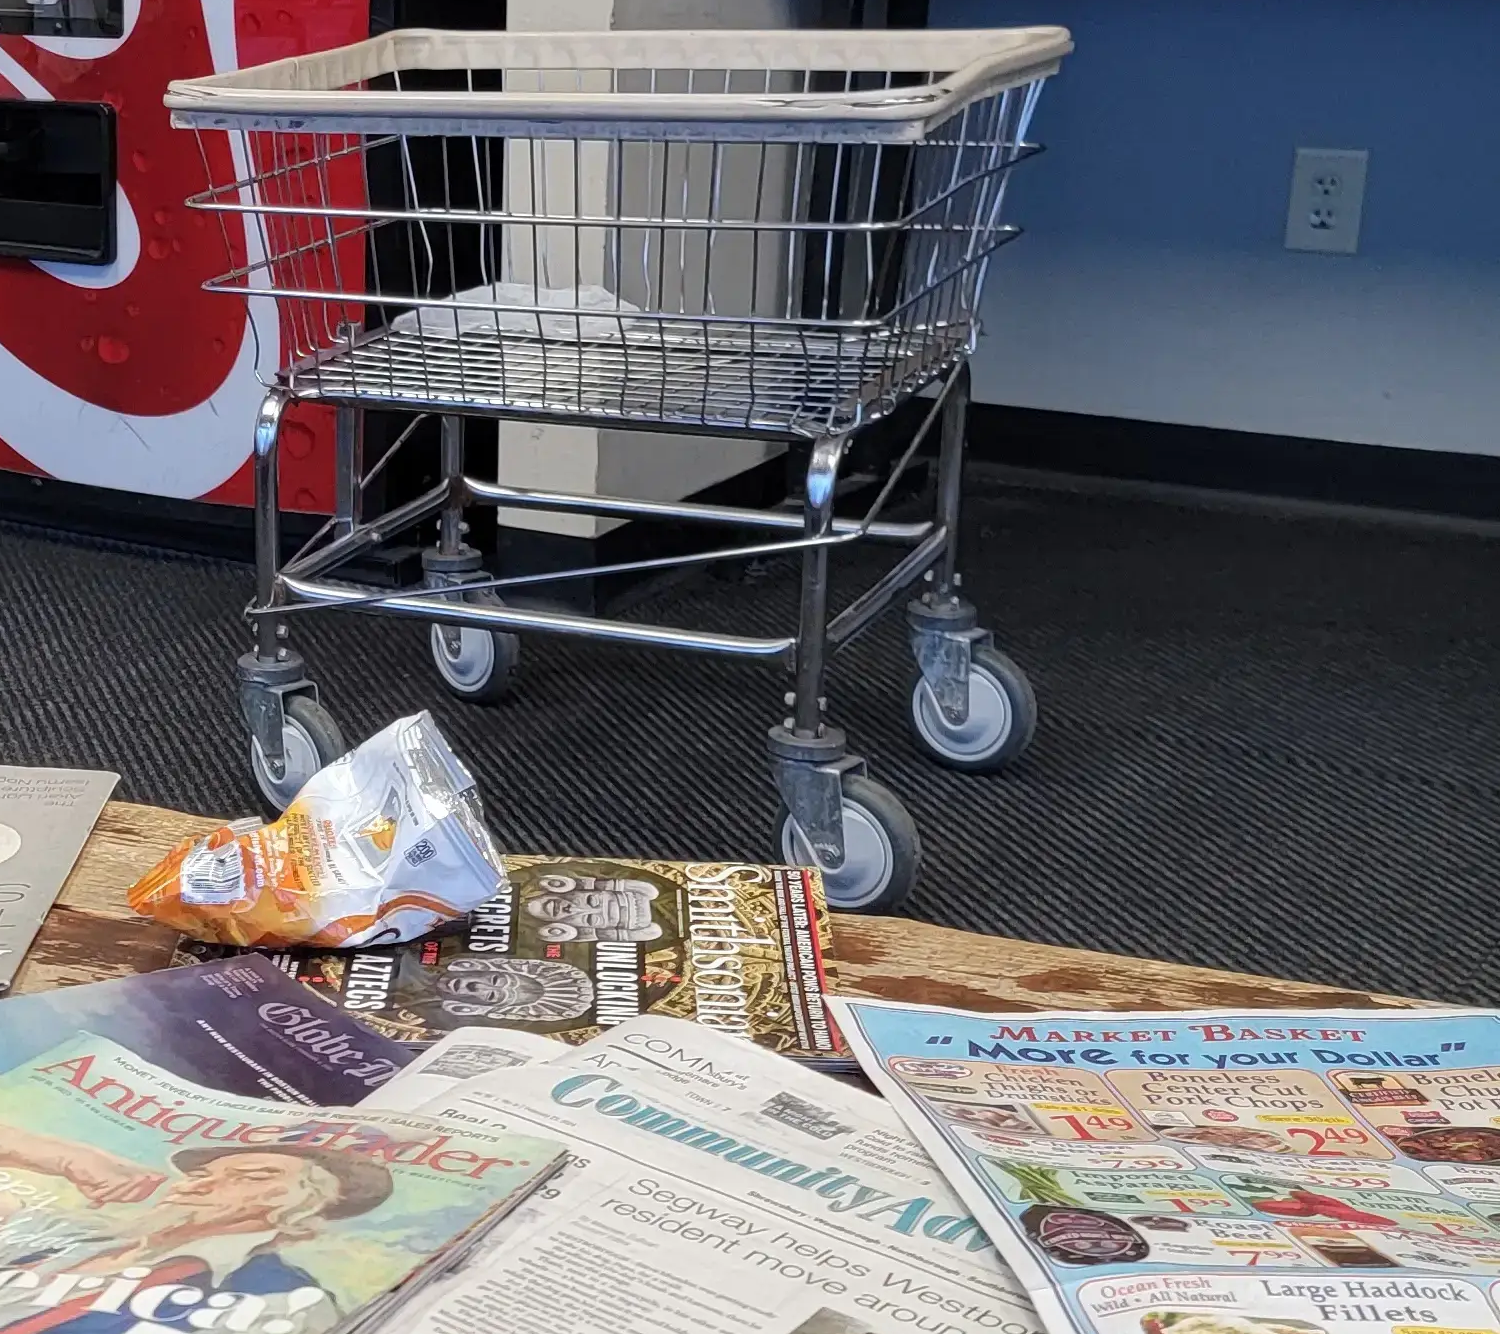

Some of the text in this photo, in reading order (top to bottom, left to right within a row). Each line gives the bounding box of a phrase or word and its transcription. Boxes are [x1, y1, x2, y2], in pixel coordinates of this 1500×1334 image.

[786, 870, 801, 880] 50
[789, 881, 805, 904] YEARS
[468, 880, 514, 954] ECRETS
[545, 943, 562, 959] THE
[796, 929, 814, 972] AMERICAN
[343, 953, 395, 1011] AZTECS
[804, 971, 818, 994] POWS
[807, 993, 826, 1022] RETURN
[258, 1002, 363, 1065] Globe
[812, 1021, 828, 1033] TO
[989, 1023, 1368, 1044] MARKET BASKET
[812, 1030, 833, 1052] HANOI
[1129, 1049, 1191, 1066] for
[1203, 1049, 1299, 1069] your
[983, 1071, 1084, 1088] Chicken
[1145, 1070, 1282, 1085] Boneless
[112, 1055, 154, 1082] MONET
[154, 1078, 213, 1104] JEWELRY
[219, 1098, 255, 1114] UNCLE
[255, 1103, 286, 1117] SAM
[389, 1116, 432, 1131] SALES
[433, 1124, 501, 1144] REPORTS
[984, 1089, 1113, 1107] Drumsticks
[985, 1081, 1102, 1098] Thighs or
[1141, 1081, 1309, 1098] Center Cut
[1141, 1093, 1325, 1113] Pork Chops
[1436, 1096, 1486, 1112] Pot
[34, 1054, 530, 1180] Antique Trader
[843, 1143, 898, 1166] program
[1070, 1170, 1195, 1184] Imported
[1073, 1178, 1215, 1193] Asparagus
[1347, 1197, 1469, 1218] Tomatoes
[1355, 1191, 1431, 1206] Plum
[626, 1176, 774, 1241] Segway
[777, 1228, 871, 1283] helps
[1192, 1217, 1276, 1232] Roast
[1210, 1227, 1277, 1242] Beef
[599, 1197, 743, 1261] resident
[743, 1256, 848, 1300] move
[1099, 1276, 1213, 1300] Ocean Fresh
[1259, 1278, 1470, 1304] Large Haddock
[1089, 1290, 1239, 1314] Wild All Natural
[1318, 1304, 1440, 1324] Fillets
